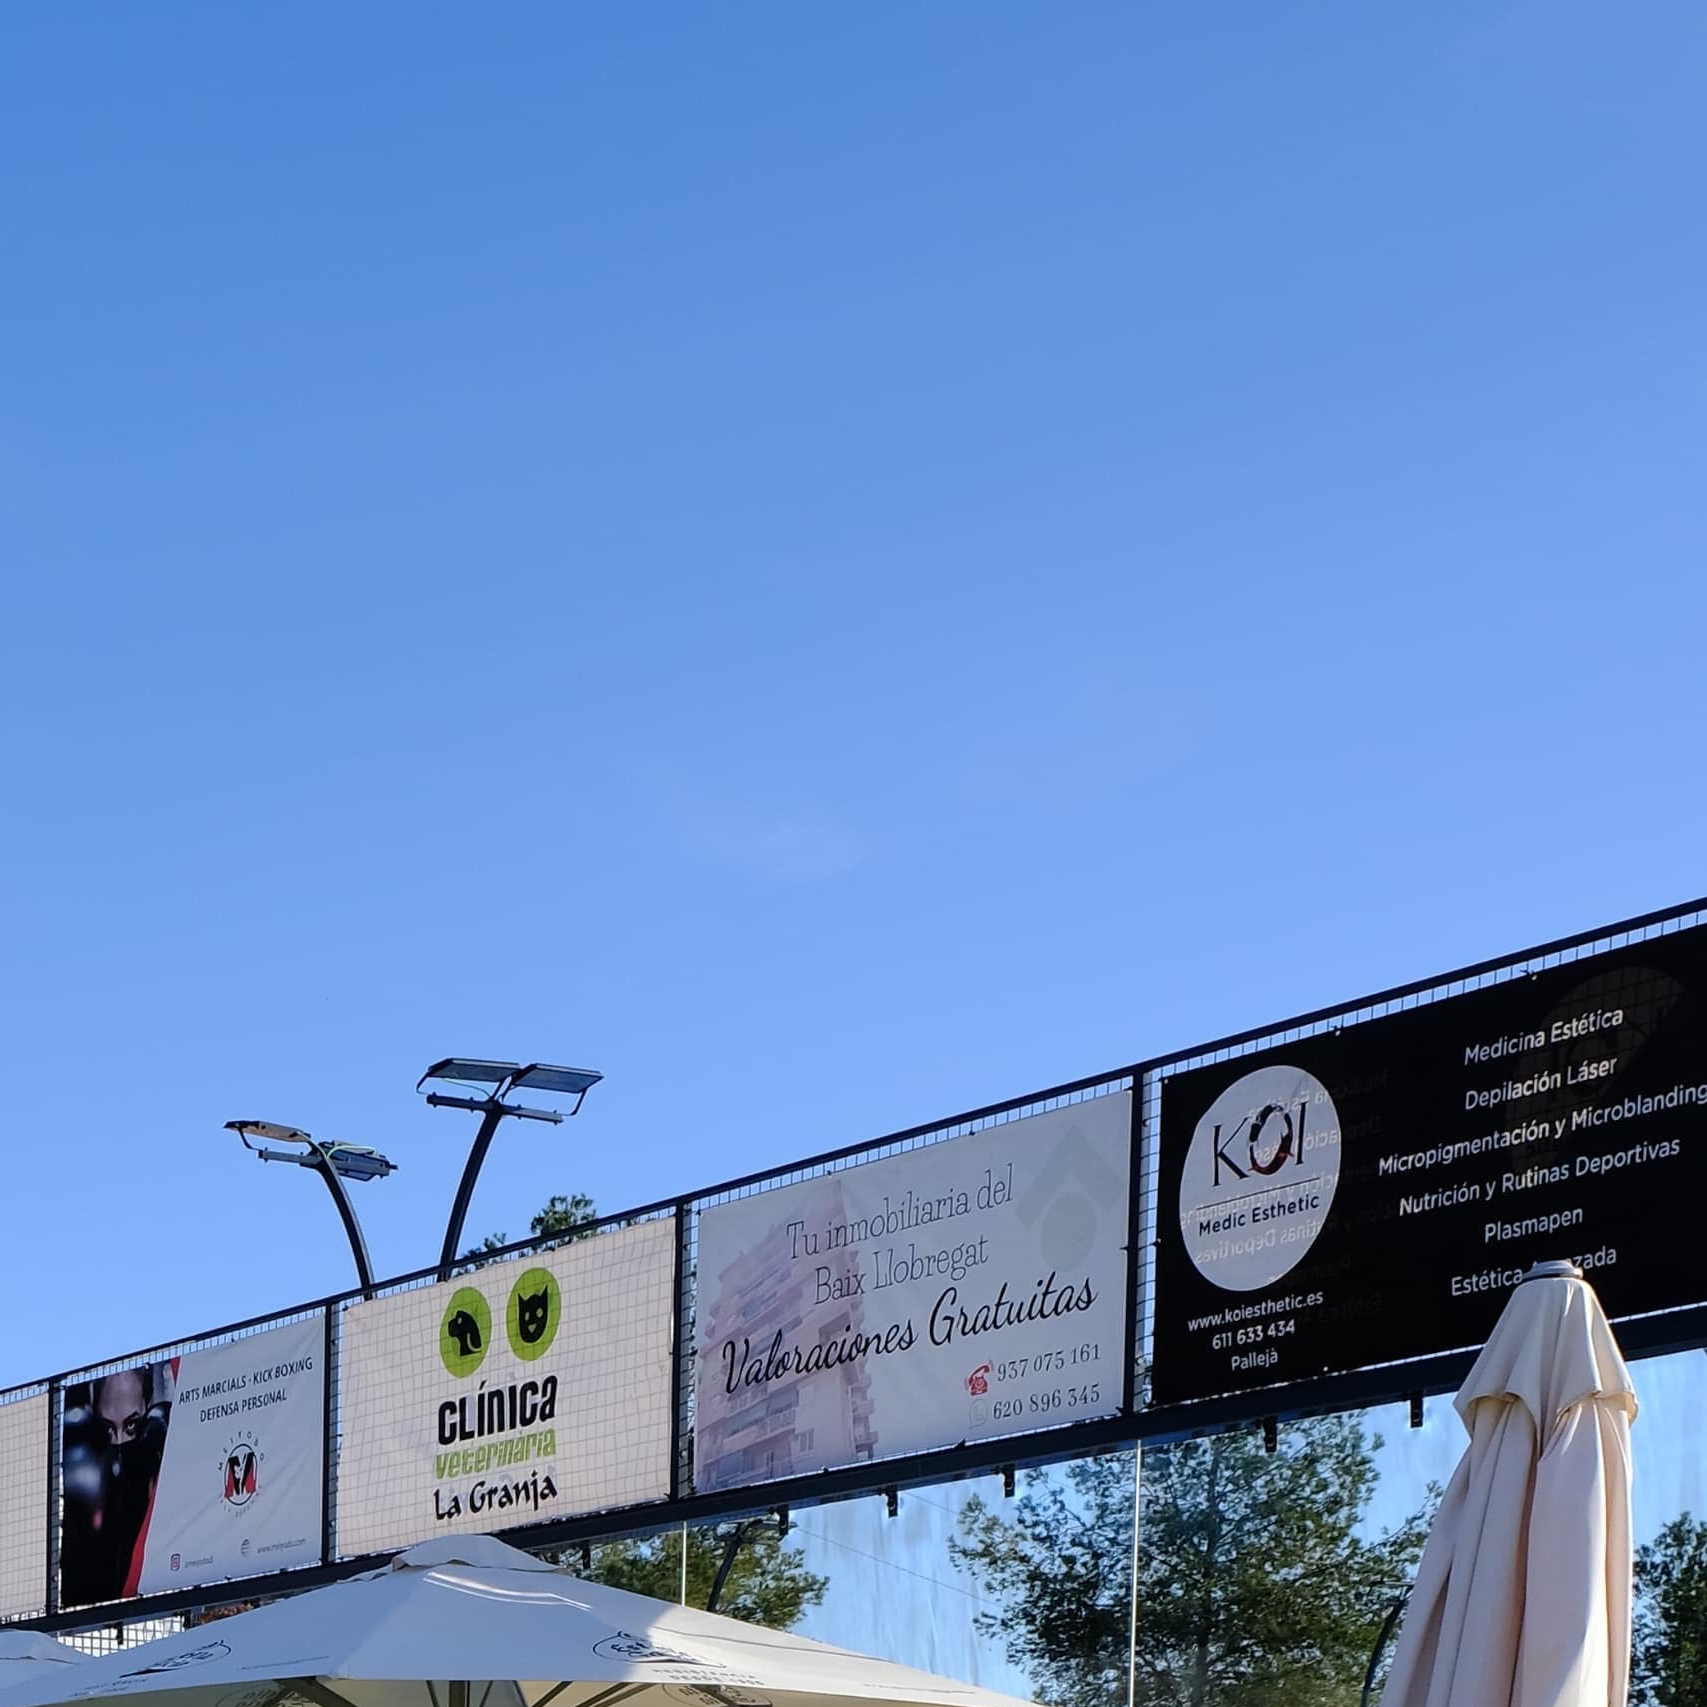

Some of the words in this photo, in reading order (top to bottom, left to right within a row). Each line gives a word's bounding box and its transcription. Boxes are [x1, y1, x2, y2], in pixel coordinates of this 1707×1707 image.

[1464, 1029, 1546, 1067] Medicina
[1550, 1006, 1624, 1043] Estética
[1465, 1070, 1562, 1116] Depilación
[1566, 1056, 1618, 1086] Láser
[1212, 1100, 1309, 1188] KOI
[1378, 1120, 1550, 1182] Micropigmentación
[1554, 1122, 1567, 1144] y
[1571, 1083, 1707, 1134] Microblanding
[1399, 1182, 1481, 1217] Nutrición
[1485, 1180, 1497, 1202] y
[1501, 1162, 1570, 1195] Rutinas
[1574, 1137, 1681, 1182] Deportivas
[787, 1220, 820, 1260] Tu
[827, 1191, 971, 1249] inmobiliaria
[977, 1162, 1014, 1209] del
[1199, 1213, 1246, 1237] Medic
[1251, 1194, 1320, 1224] Esthetic
[1484, 1206, 1584, 1244] Plasmapen
[815, 1264, 867, 1305] Baix
[874, 1235, 990, 1291] Llobregat
[1450, 1264, 1525, 1297] Estética
[722, 1319, 920, 1394] Valoraciones
[929, 1270, 1099, 1346] Gratuitas
[1188, 1290, 1324, 1332] www.koiesthetic.es
[1212, 1331, 1234, 1350] 611
[1236, 1325, 1264, 1345] 633
[1267, 1319, 1296, 1340] 434
[179, 1387, 200, 1405] ARTS
[202, 1377, 247, 1402] MARCIALS
[253, 1371, 273, 1387] KICK
[275, 1356, 313, 1379] BOXING
[996, 1361, 1030, 1383] 937
[1033, 1352, 1065, 1375] 075
[1071, 1343, 1101, 1365] 161
[1231, 1348, 1279, 1372] Pallejà
[200, 1403, 239, 1422] DEFENSA
[242, 1389, 287, 1412] PERSONAL
[993, 1399, 1024, 1420] 620
[1029, 1394, 1061, 1416] 896
[1067, 1384, 1101, 1409] 345
[469, 1470, 558, 1512] Granja
